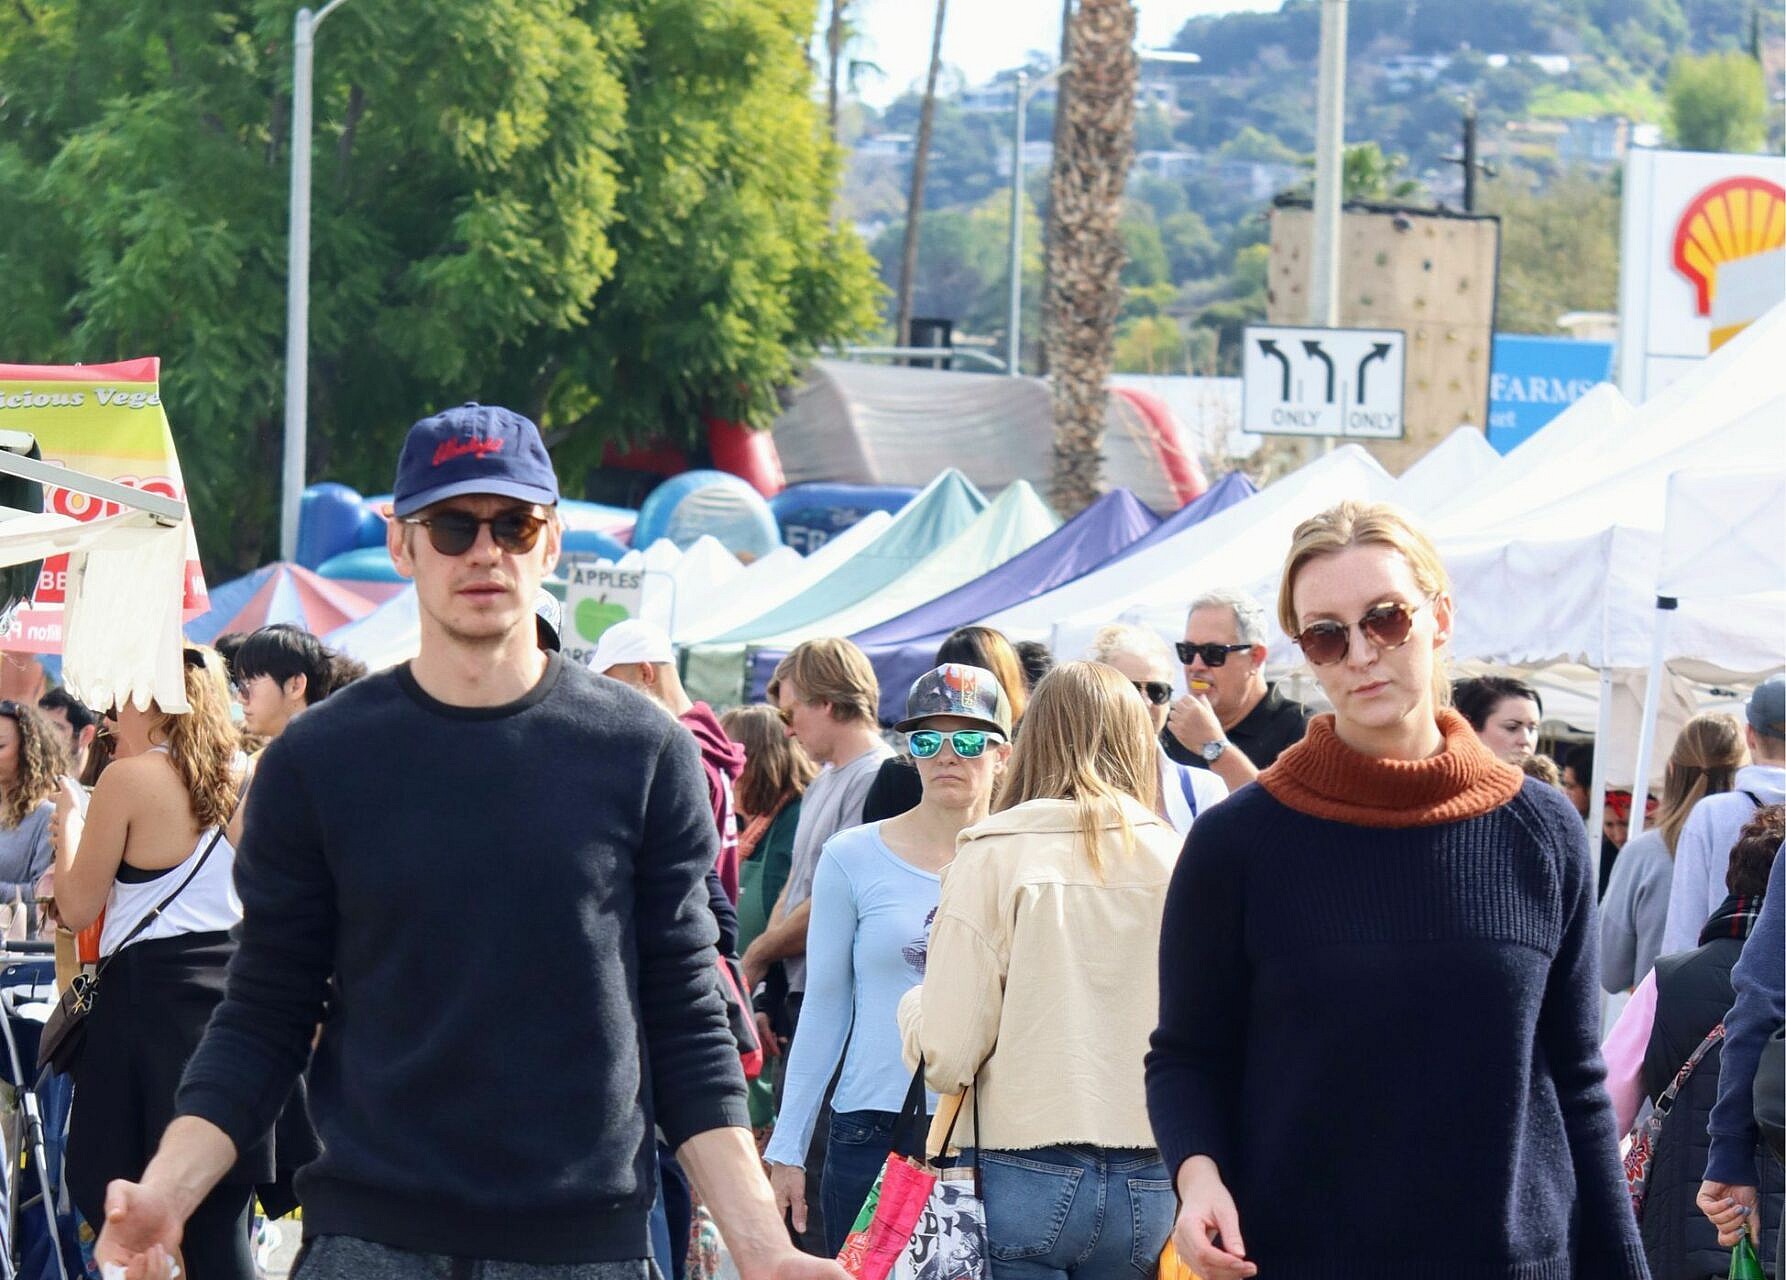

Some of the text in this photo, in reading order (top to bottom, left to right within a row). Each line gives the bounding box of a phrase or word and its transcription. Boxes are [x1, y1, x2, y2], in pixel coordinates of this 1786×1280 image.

[1271, 408, 1322, 427] ONLY
[1350, 411, 1397, 430] ONLY
[574, 569, 640, 589] APPLES
